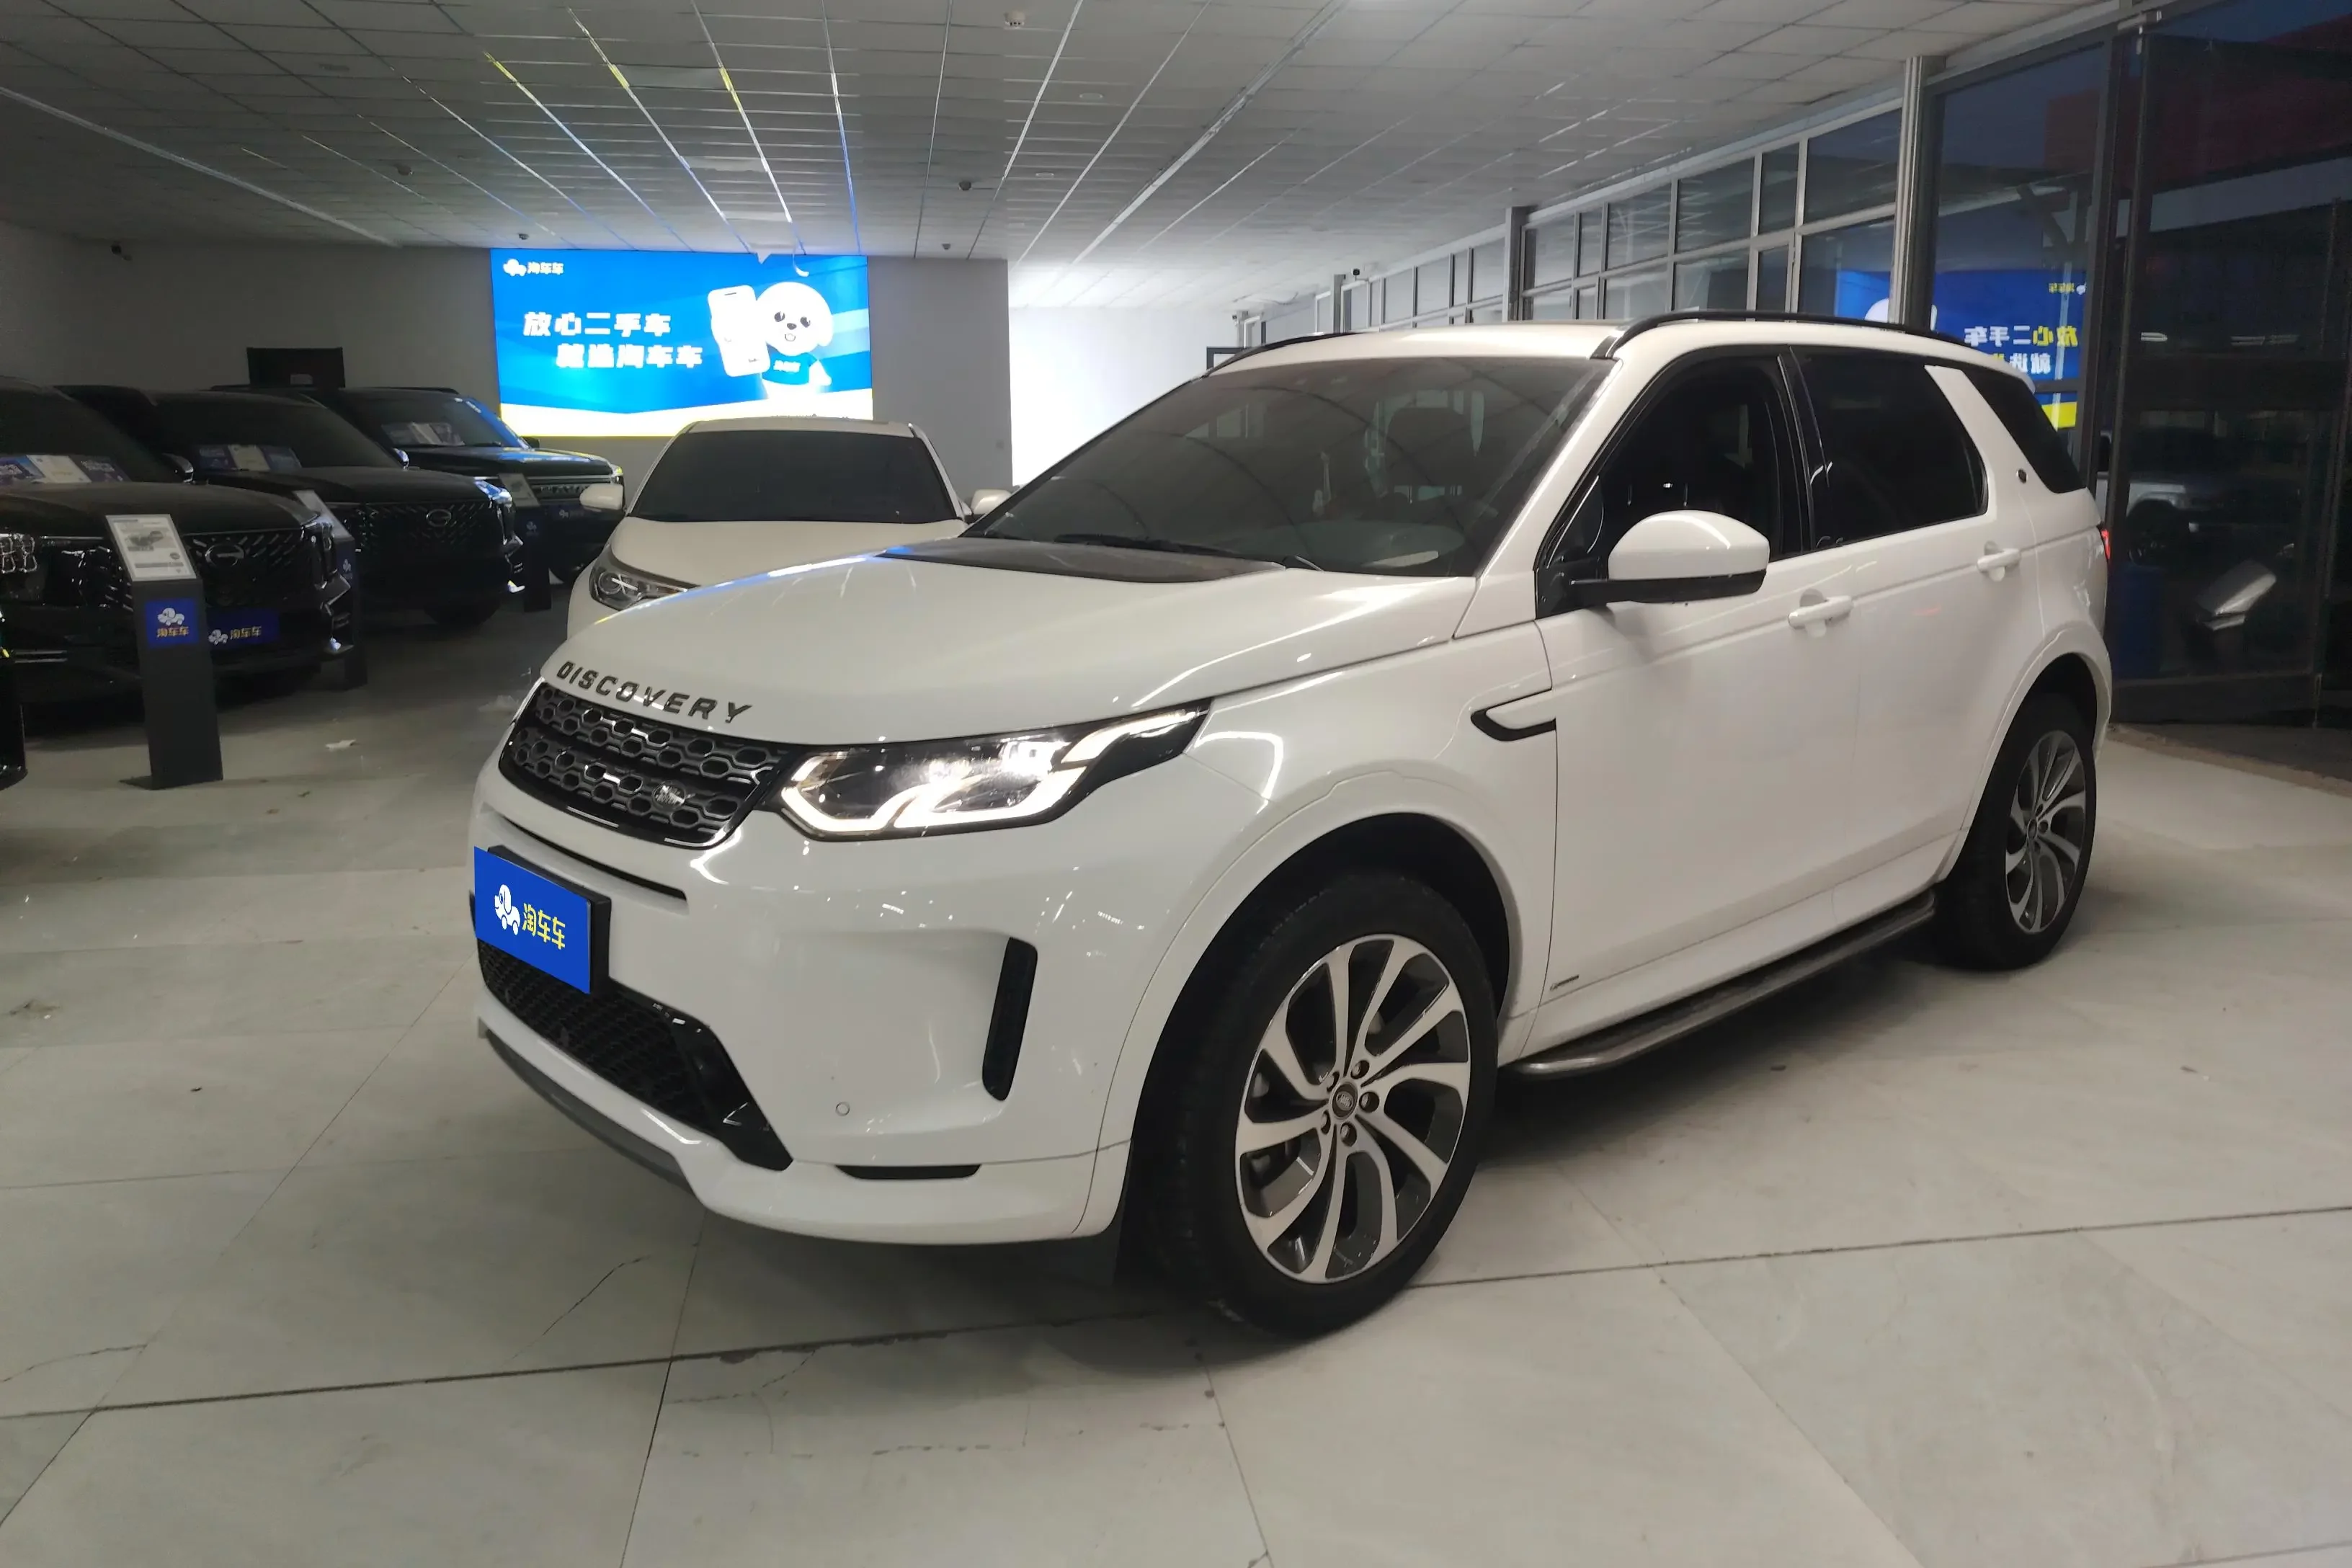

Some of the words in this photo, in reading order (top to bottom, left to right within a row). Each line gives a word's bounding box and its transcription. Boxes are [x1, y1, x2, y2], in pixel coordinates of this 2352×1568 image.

[523, 312, 672, 337] 放心二手车
[556, 661, 752, 723] DISCOVERY
[522, 902, 566, 950] 淘车车
